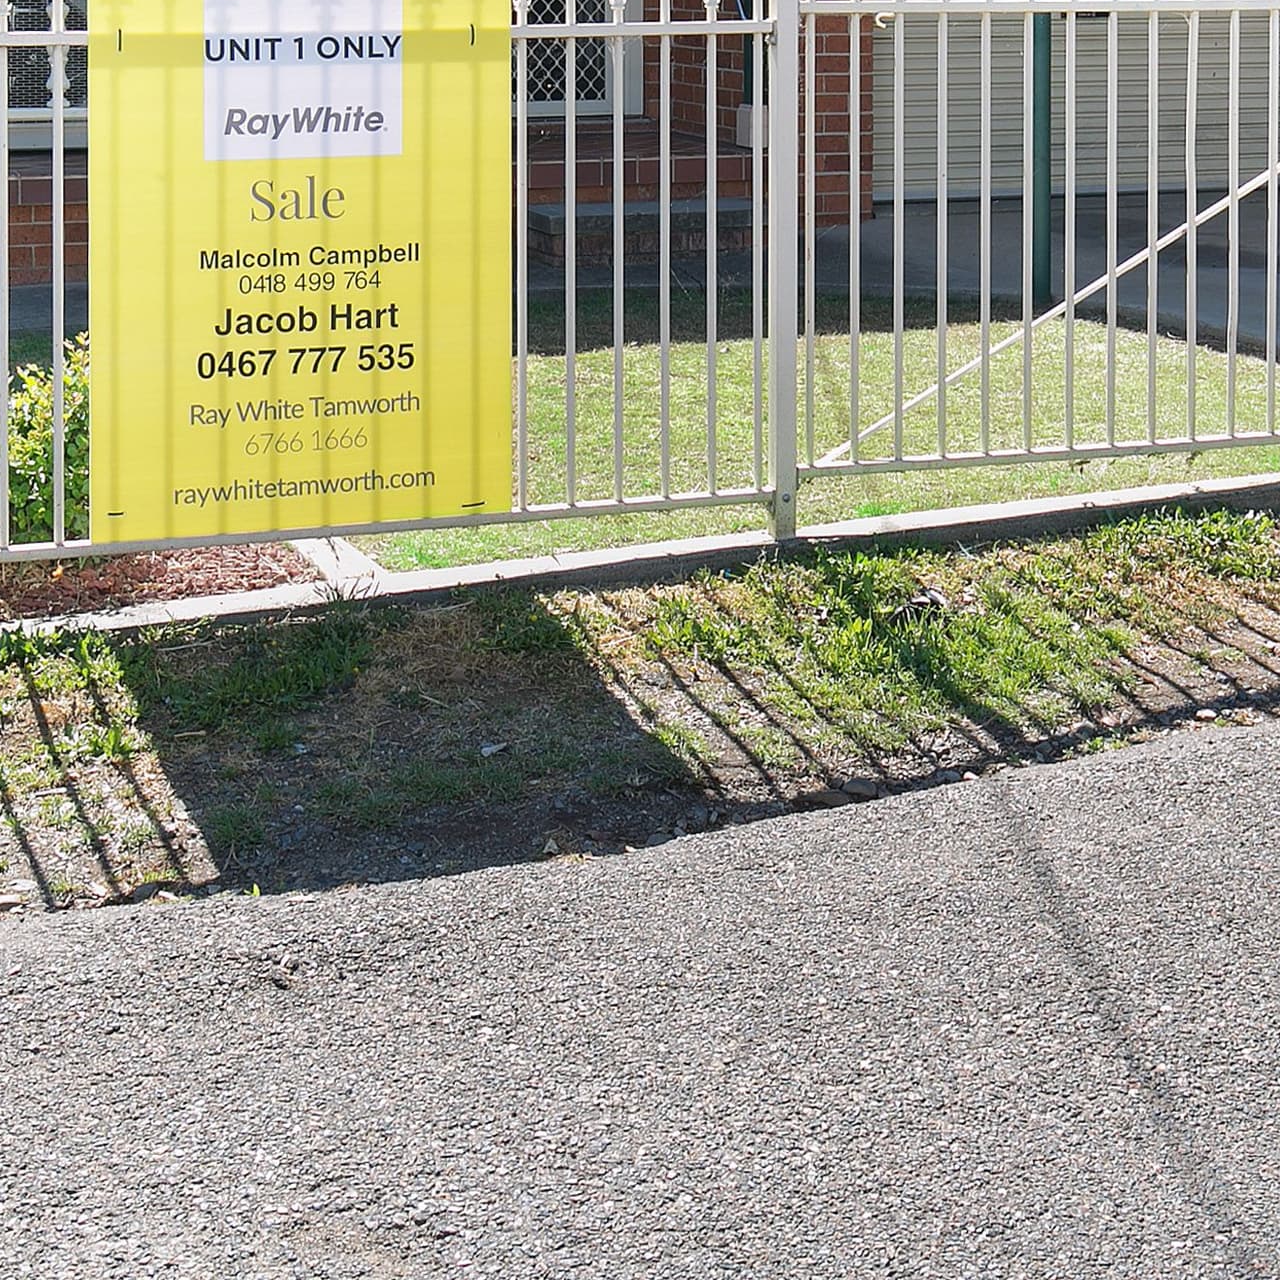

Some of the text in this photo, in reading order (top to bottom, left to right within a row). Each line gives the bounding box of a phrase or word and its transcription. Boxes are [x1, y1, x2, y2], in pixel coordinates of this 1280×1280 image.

[205, 35, 402, 62] UNIT 1 ONLY
[250, 175, 345, 222] Sale
[199, 242, 420, 270] Malcolm Campbell
[239, 269, 382, 295] 0418 499 764
[214, 303, 399, 336] Jacob Hart
[197, 343, 415, 380] 0467 777 535
[190, 391, 421, 429] Ray White Tamworth
[244, 426, 369, 456] 6766 1666
[174, 469, 436, 508] raywhitetamworth.com
